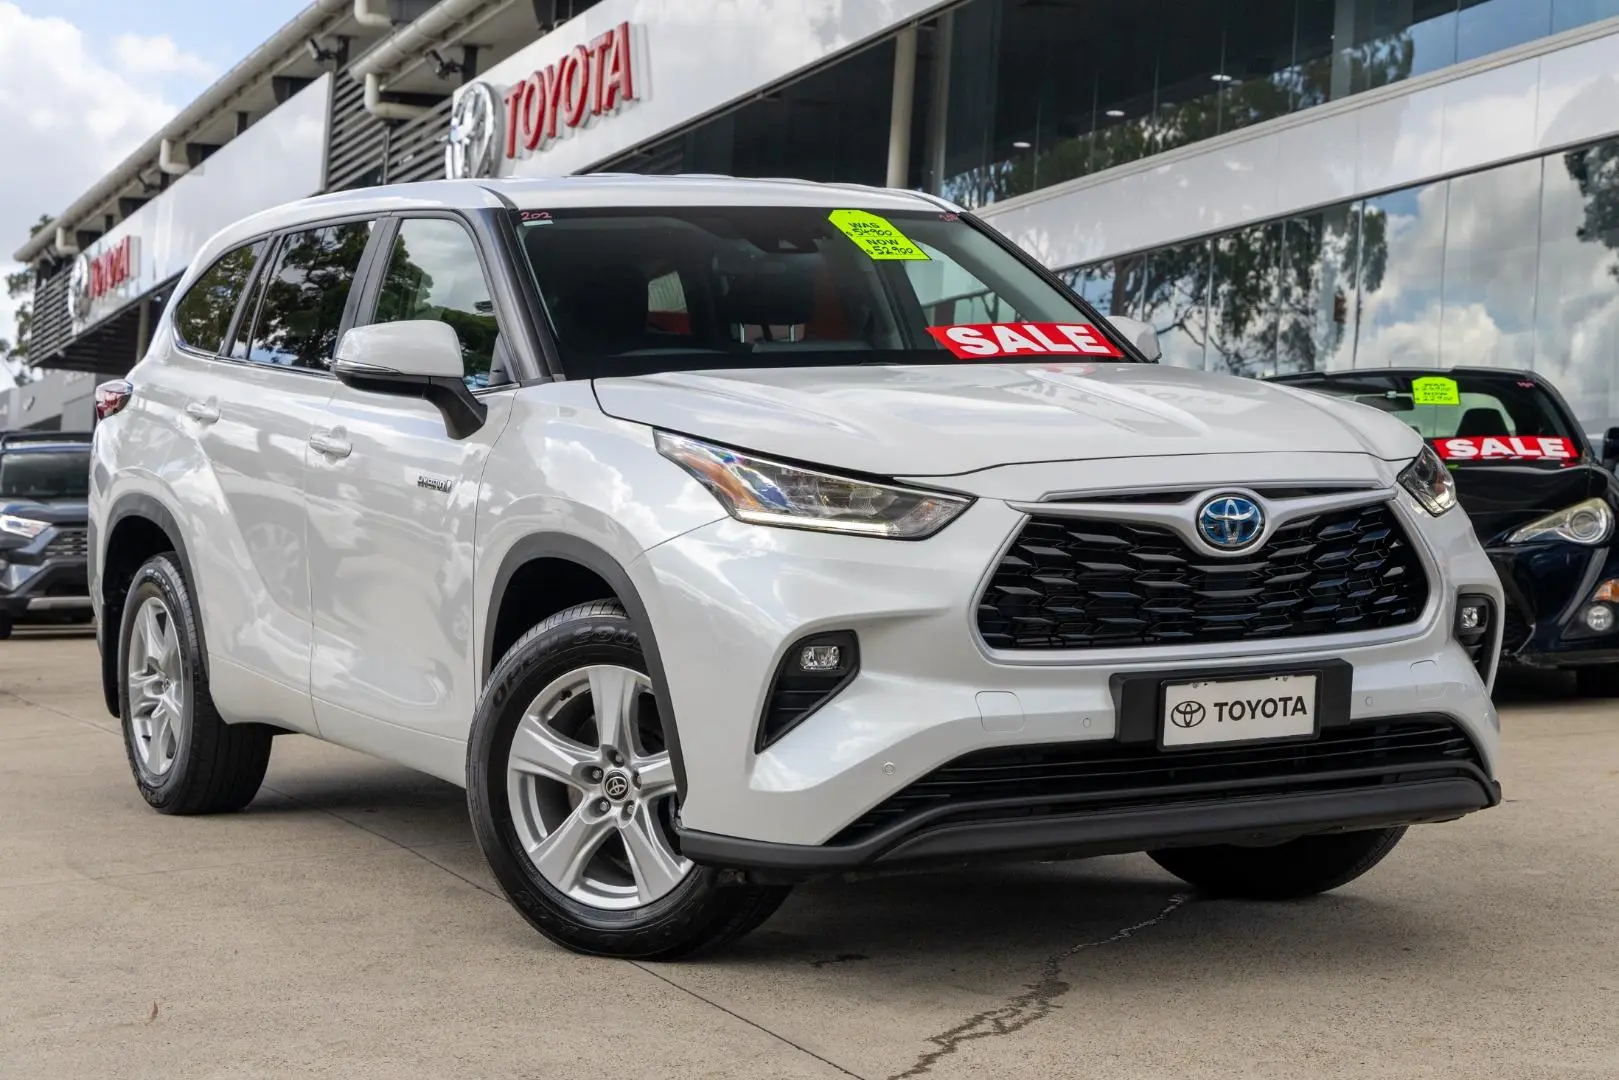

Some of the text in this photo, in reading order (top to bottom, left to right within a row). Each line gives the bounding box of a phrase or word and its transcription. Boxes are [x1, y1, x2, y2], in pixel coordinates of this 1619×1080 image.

[504, 20, 633, 160] TOYOTA
[945, 325, 1112, 356] SALE
[1445, 437, 1571, 458] SALE
[1213, 695, 1308, 723] TOYOTA
